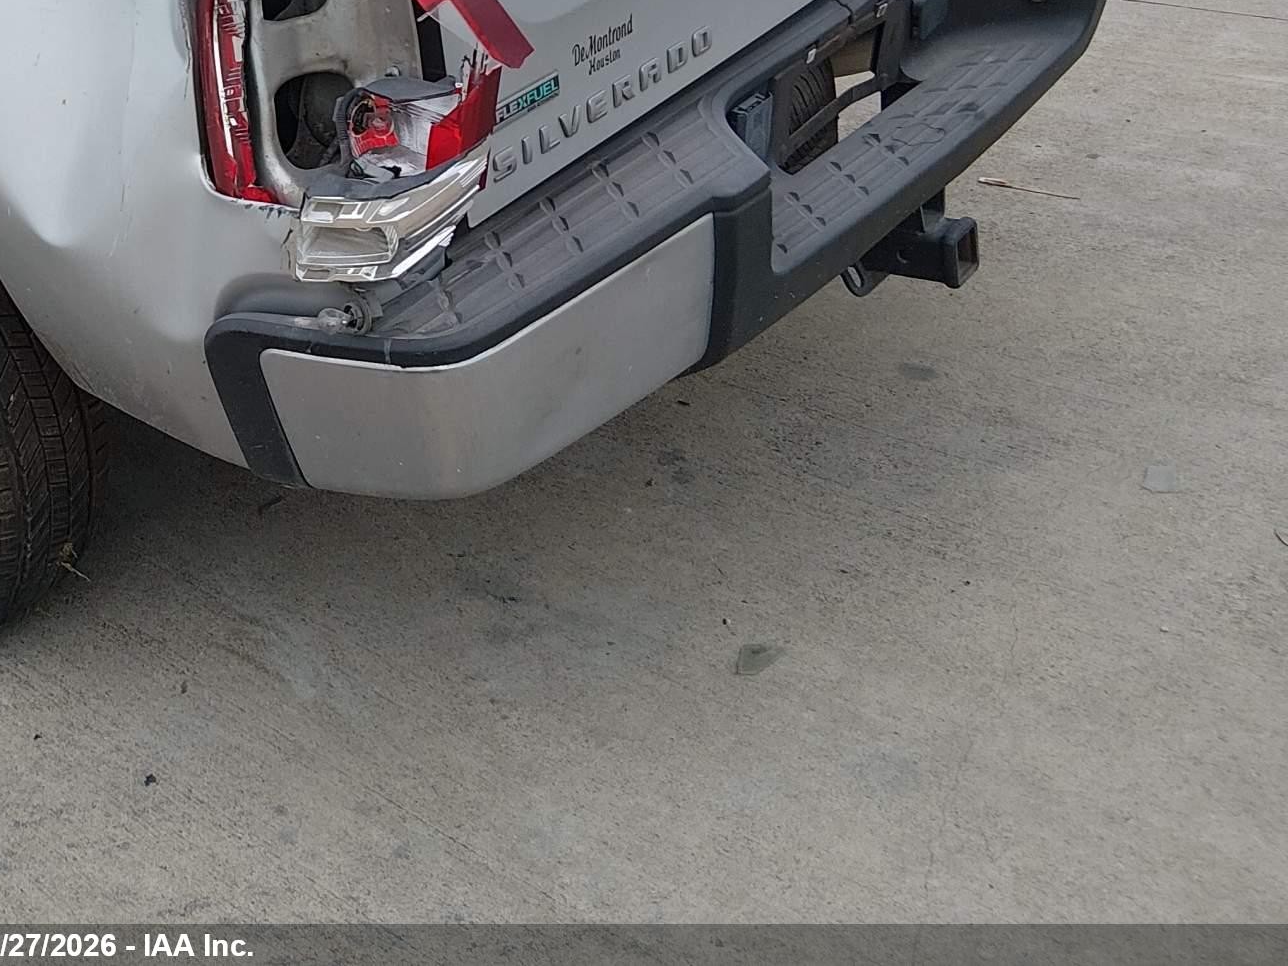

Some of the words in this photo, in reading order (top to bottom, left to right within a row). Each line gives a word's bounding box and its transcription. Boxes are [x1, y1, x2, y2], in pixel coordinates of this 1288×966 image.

[588, 49, 621, 76] Houston
[492, 25, 713, 183] SILVERADO
[496, 79, 558, 123] FLEXFUEL
